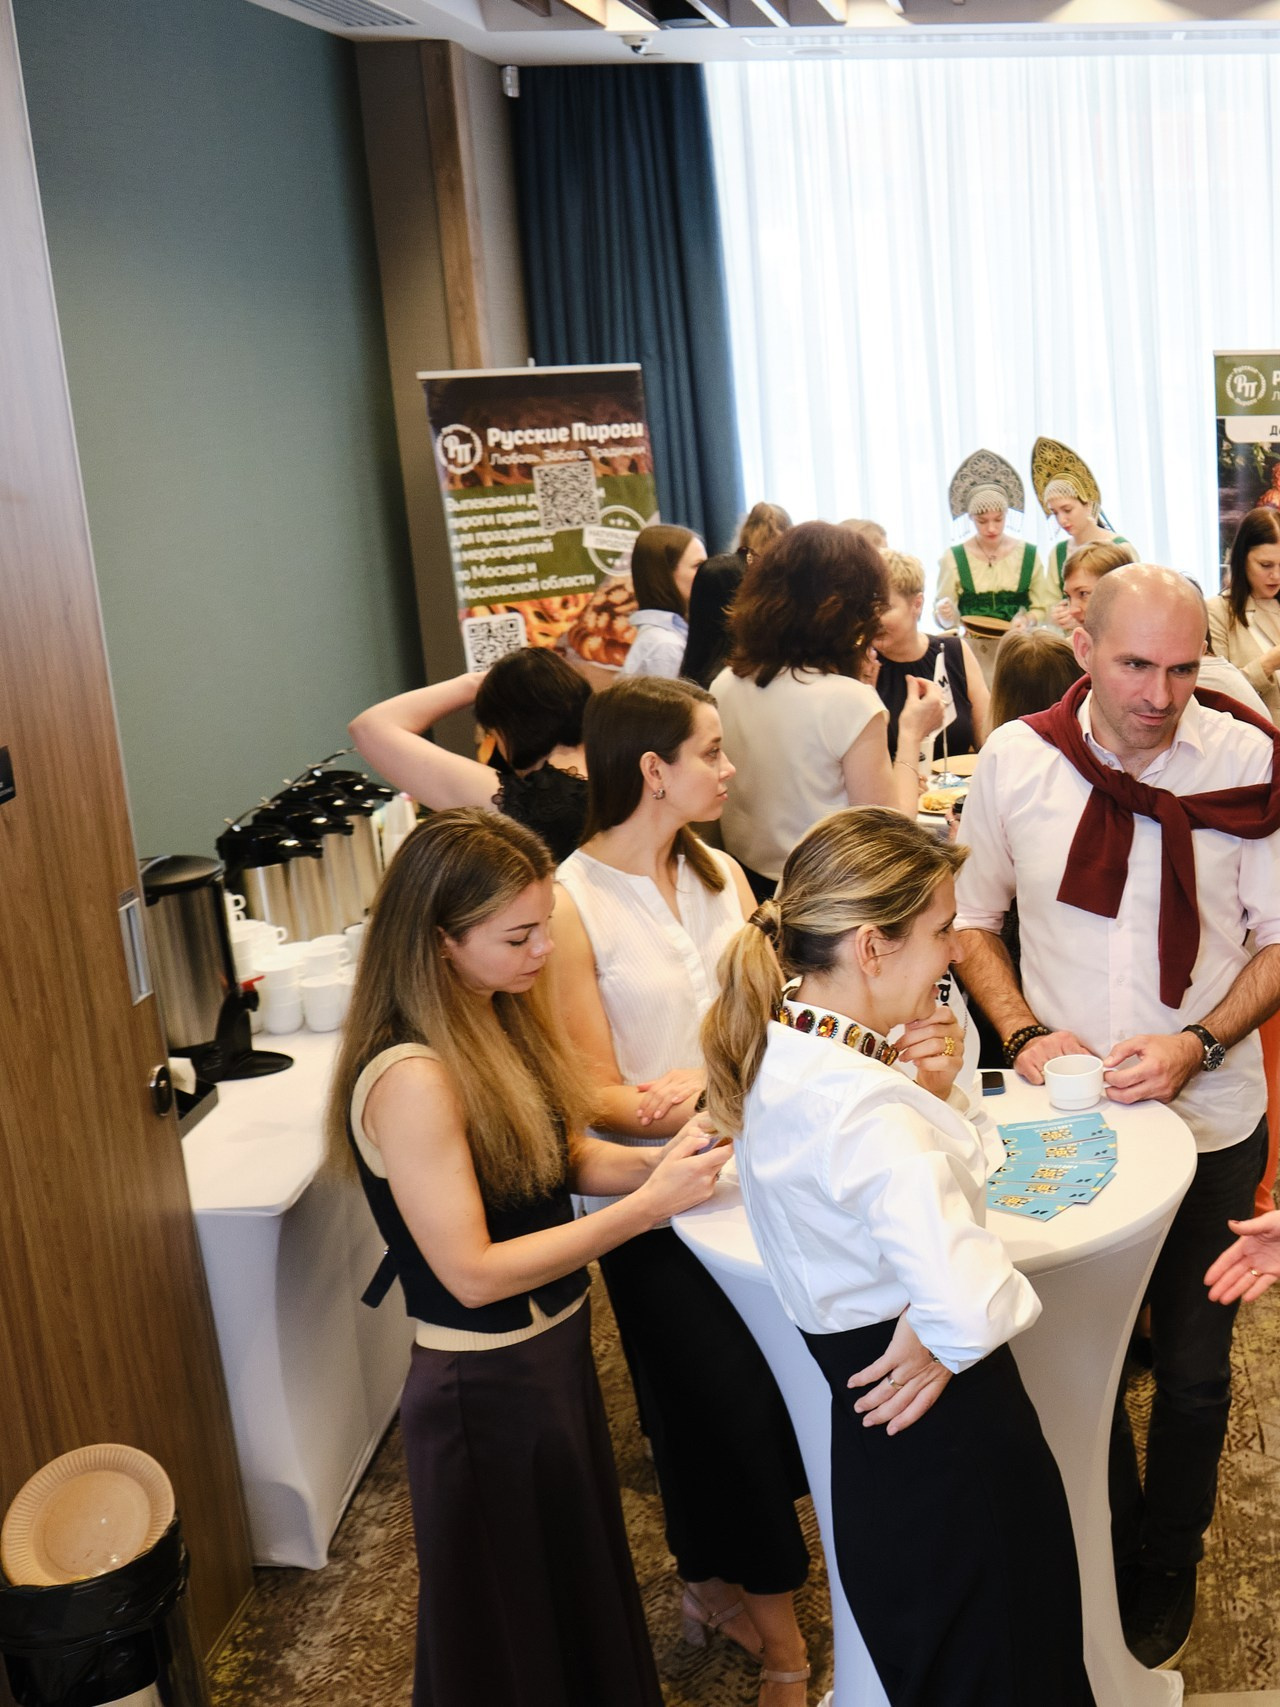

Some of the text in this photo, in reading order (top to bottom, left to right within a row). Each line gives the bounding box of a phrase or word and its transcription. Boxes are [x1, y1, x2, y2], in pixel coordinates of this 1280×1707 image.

[487, 421, 644, 450] Русские Пироги
[471, 563, 526, 580] Москве
[458, 574, 596, 600] Московской области
